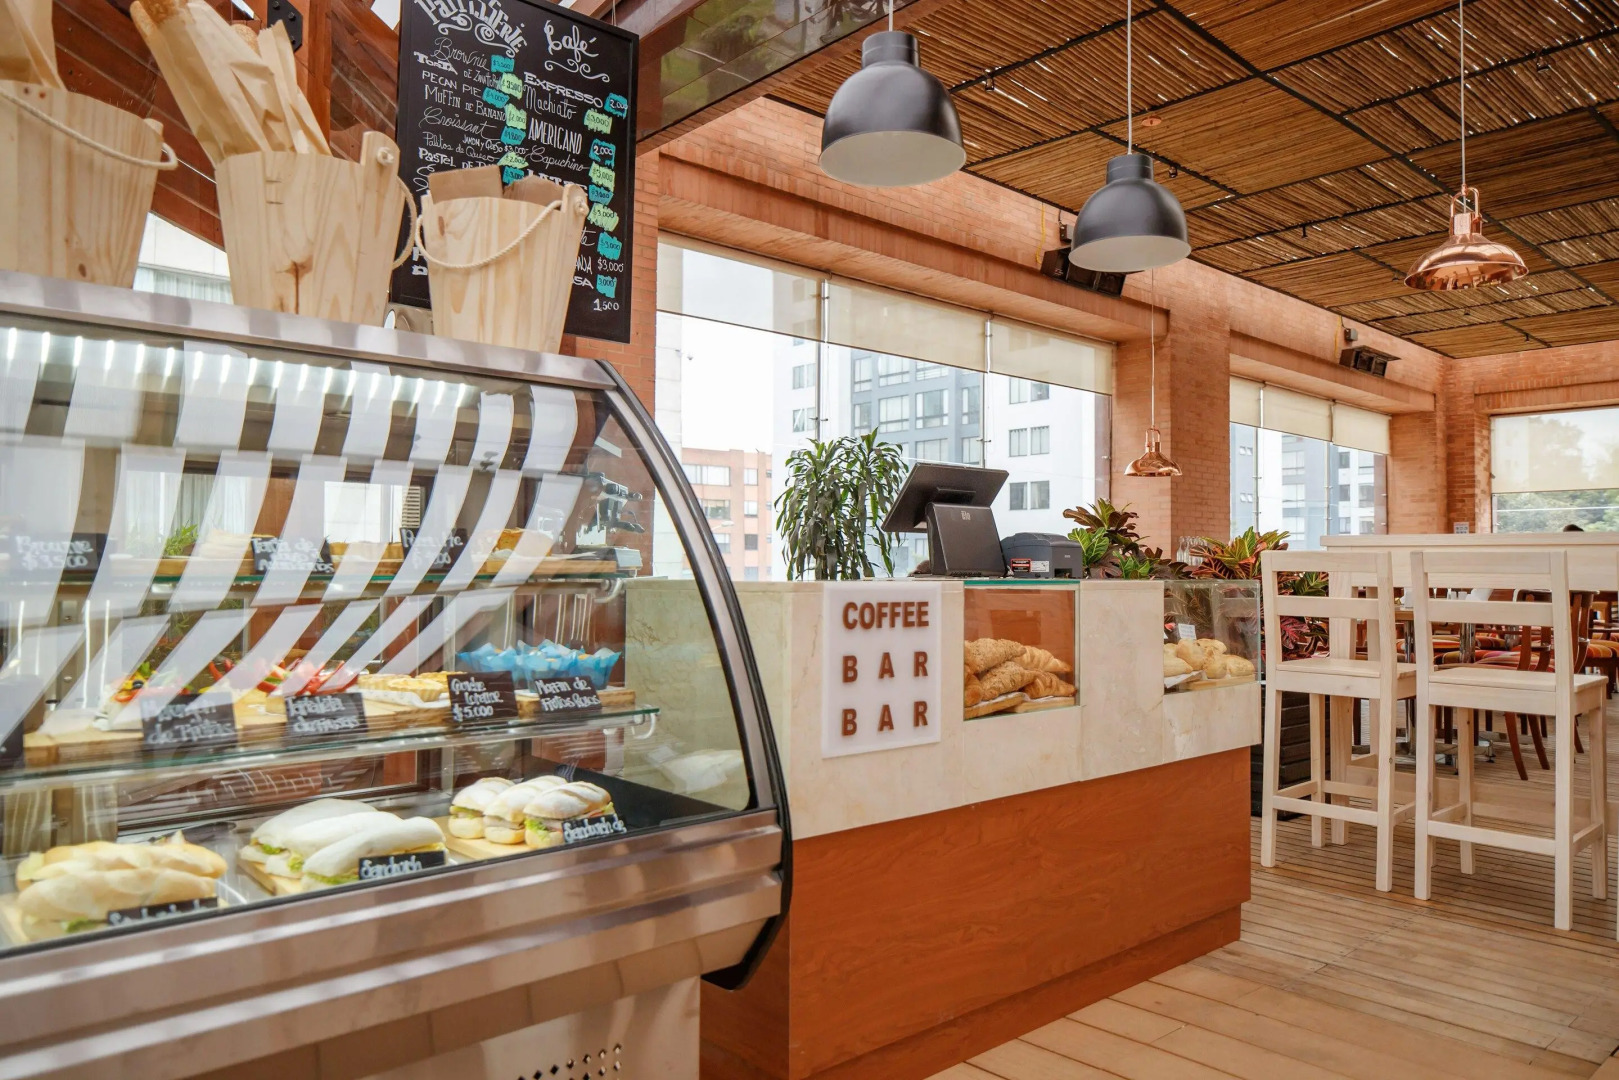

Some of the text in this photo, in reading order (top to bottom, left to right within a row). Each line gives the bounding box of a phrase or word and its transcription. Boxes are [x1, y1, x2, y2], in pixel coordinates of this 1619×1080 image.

[431, 37, 490, 71] Brownie
[543, 20, 599, 62] Café
[422, 70, 457, 89] PECAN
[462, 84, 482, 98] PIE
[523, 71, 603, 108] EXPRESSO
[419, 106, 500, 141] Croissant
[528, 117, 582, 154] AMERICANO
[525, 145, 590, 171] Capuchino
[842, 601, 930, 630] COFFEE
[842, 651, 929, 683] BAR
[841, 700, 928, 737] BAR
